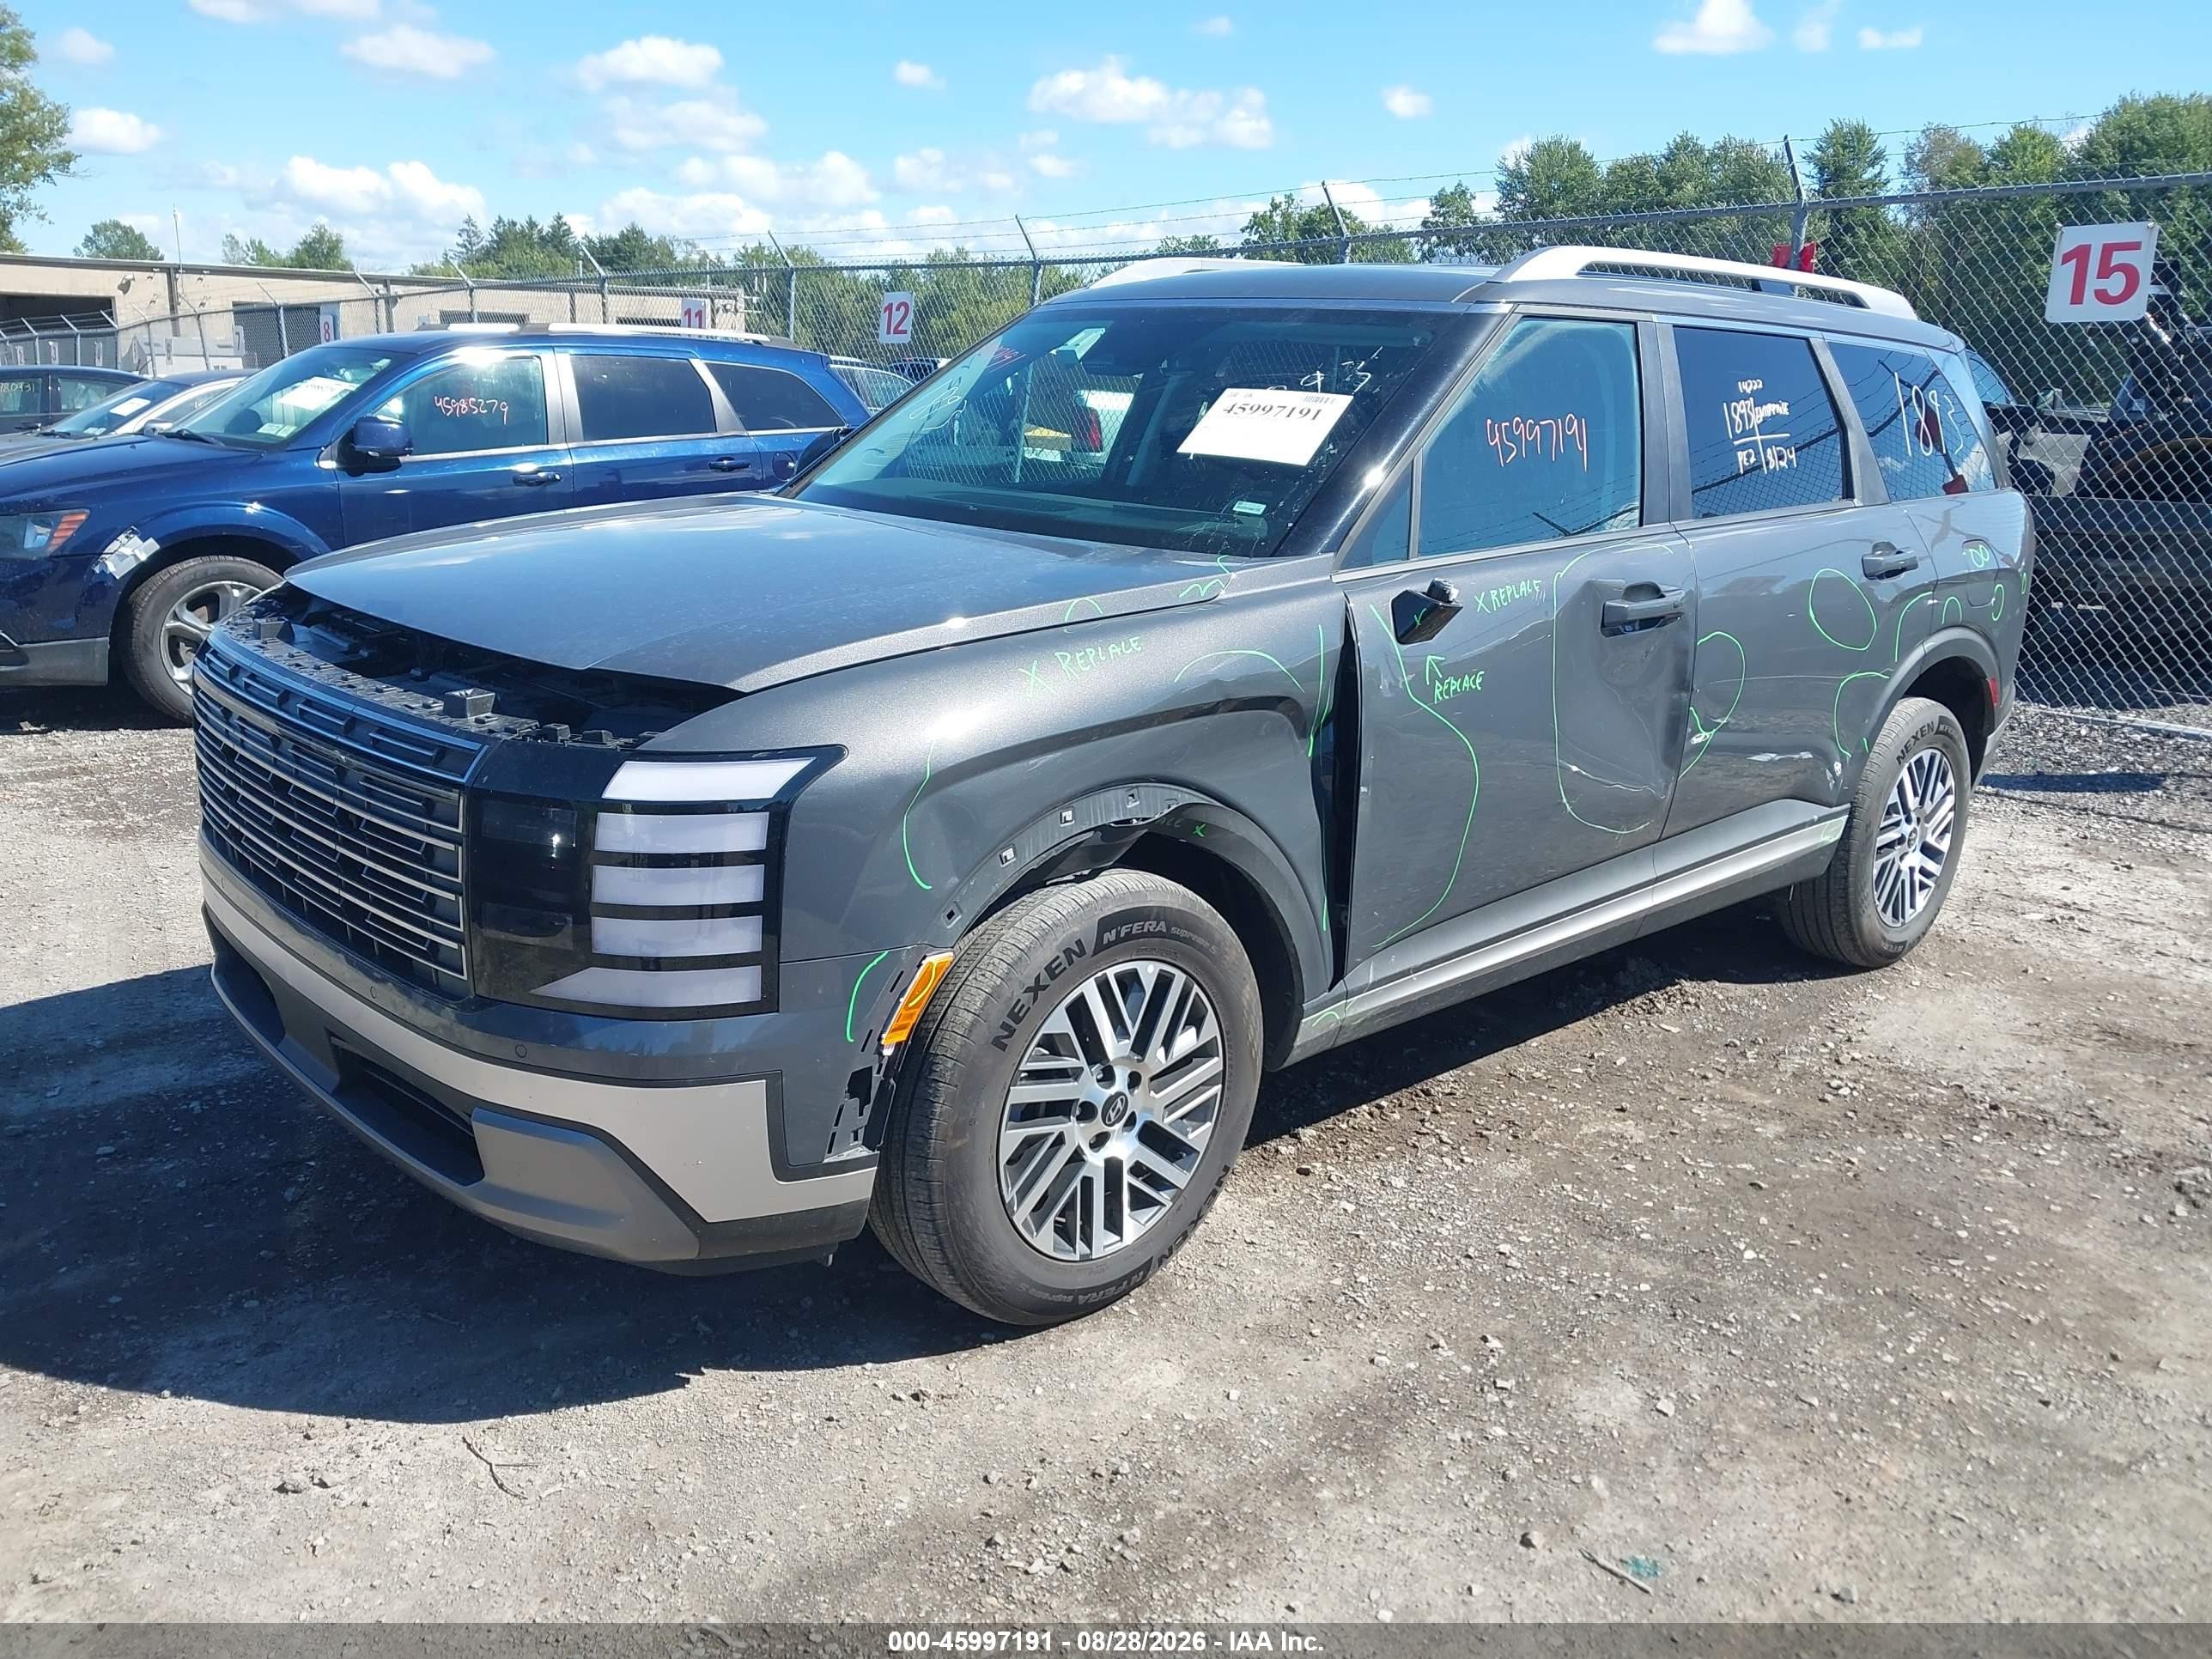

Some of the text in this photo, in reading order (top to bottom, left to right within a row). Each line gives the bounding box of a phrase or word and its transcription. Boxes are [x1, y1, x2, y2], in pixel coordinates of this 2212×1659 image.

[2061, 240, 2142, 306] 15
[323, 320, 331, 342] 8
[684, 307, 703, 329] 11
[883, 301, 910, 336] 12
[434, 396, 508, 425] 45985279
[1223, 402, 1322, 421] 45997191
[1894, 372, 1964, 457] 1893
[1486, 413, 1588, 472] 45997191
[1054, 636, 1142, 681] REPLACE
[1434, 671, 1485, 704] REPLACE
[1896, 720, 1935, 766] NEXEN
[991, 938, 1087, 1052] NEXEN
[1103, 920, 1168, 945] N'FERA
